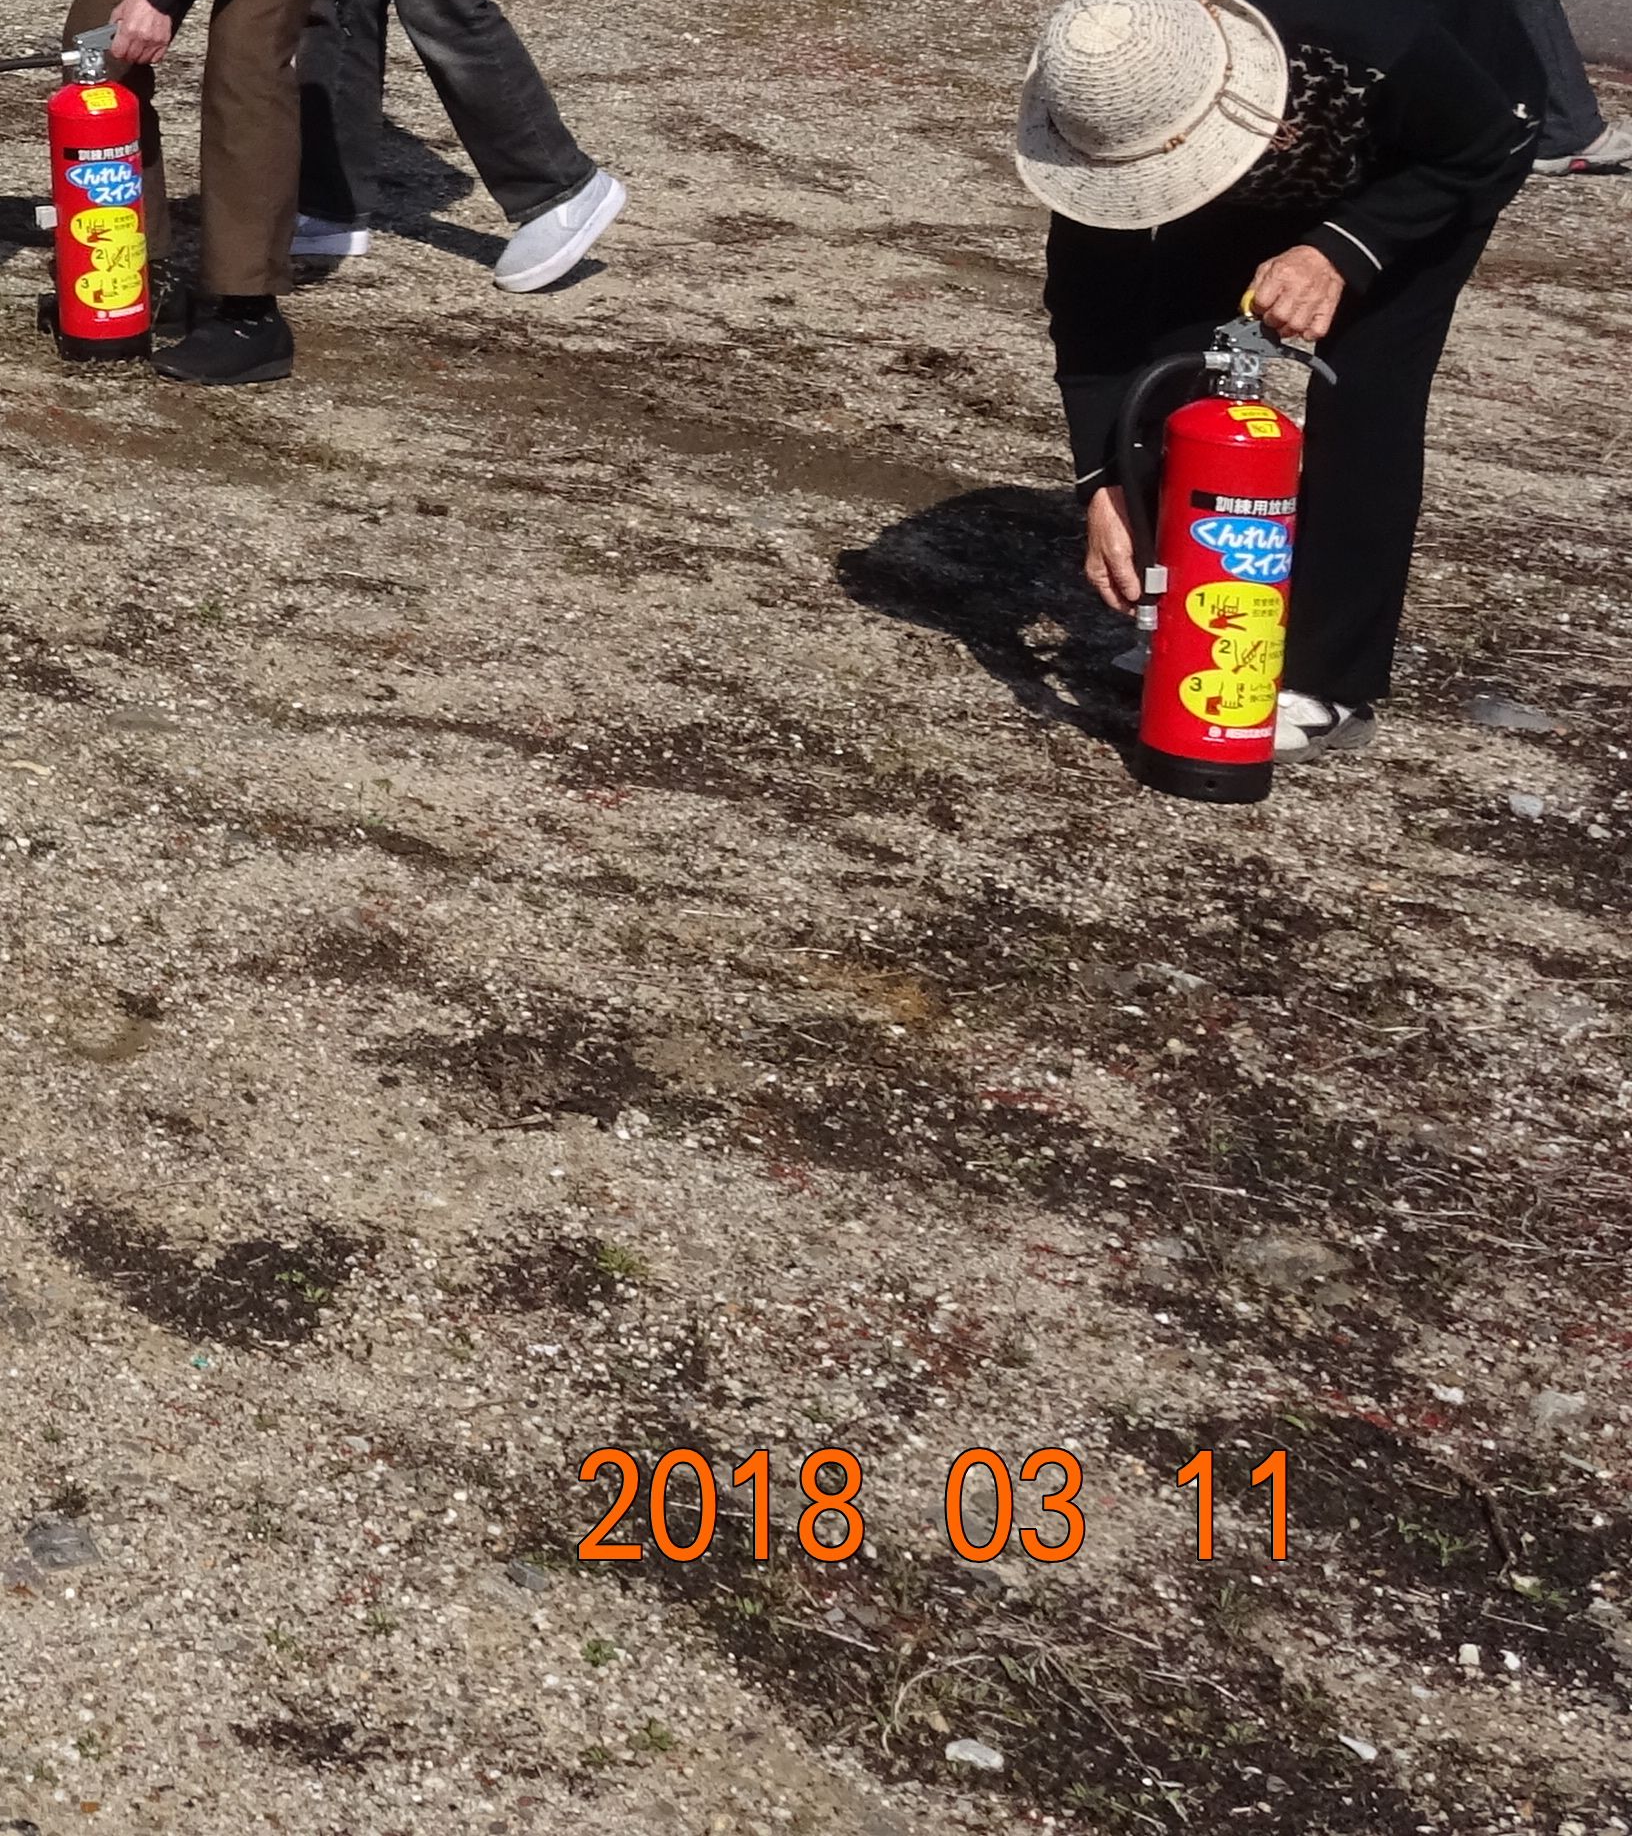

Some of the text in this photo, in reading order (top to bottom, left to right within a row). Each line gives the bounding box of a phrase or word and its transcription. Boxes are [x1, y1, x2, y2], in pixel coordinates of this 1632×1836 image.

[70, 165, 132, 185] くんれん
[96, 249, 104, 259] 2
[81, 278, 89, 288] 3
[1197, 522, 1285, 550] くんれん
[1196, 592, 1205, 607] 1
[1219, 640, 1231, 653] 2
[1189, 677, 1202, 691] 3
